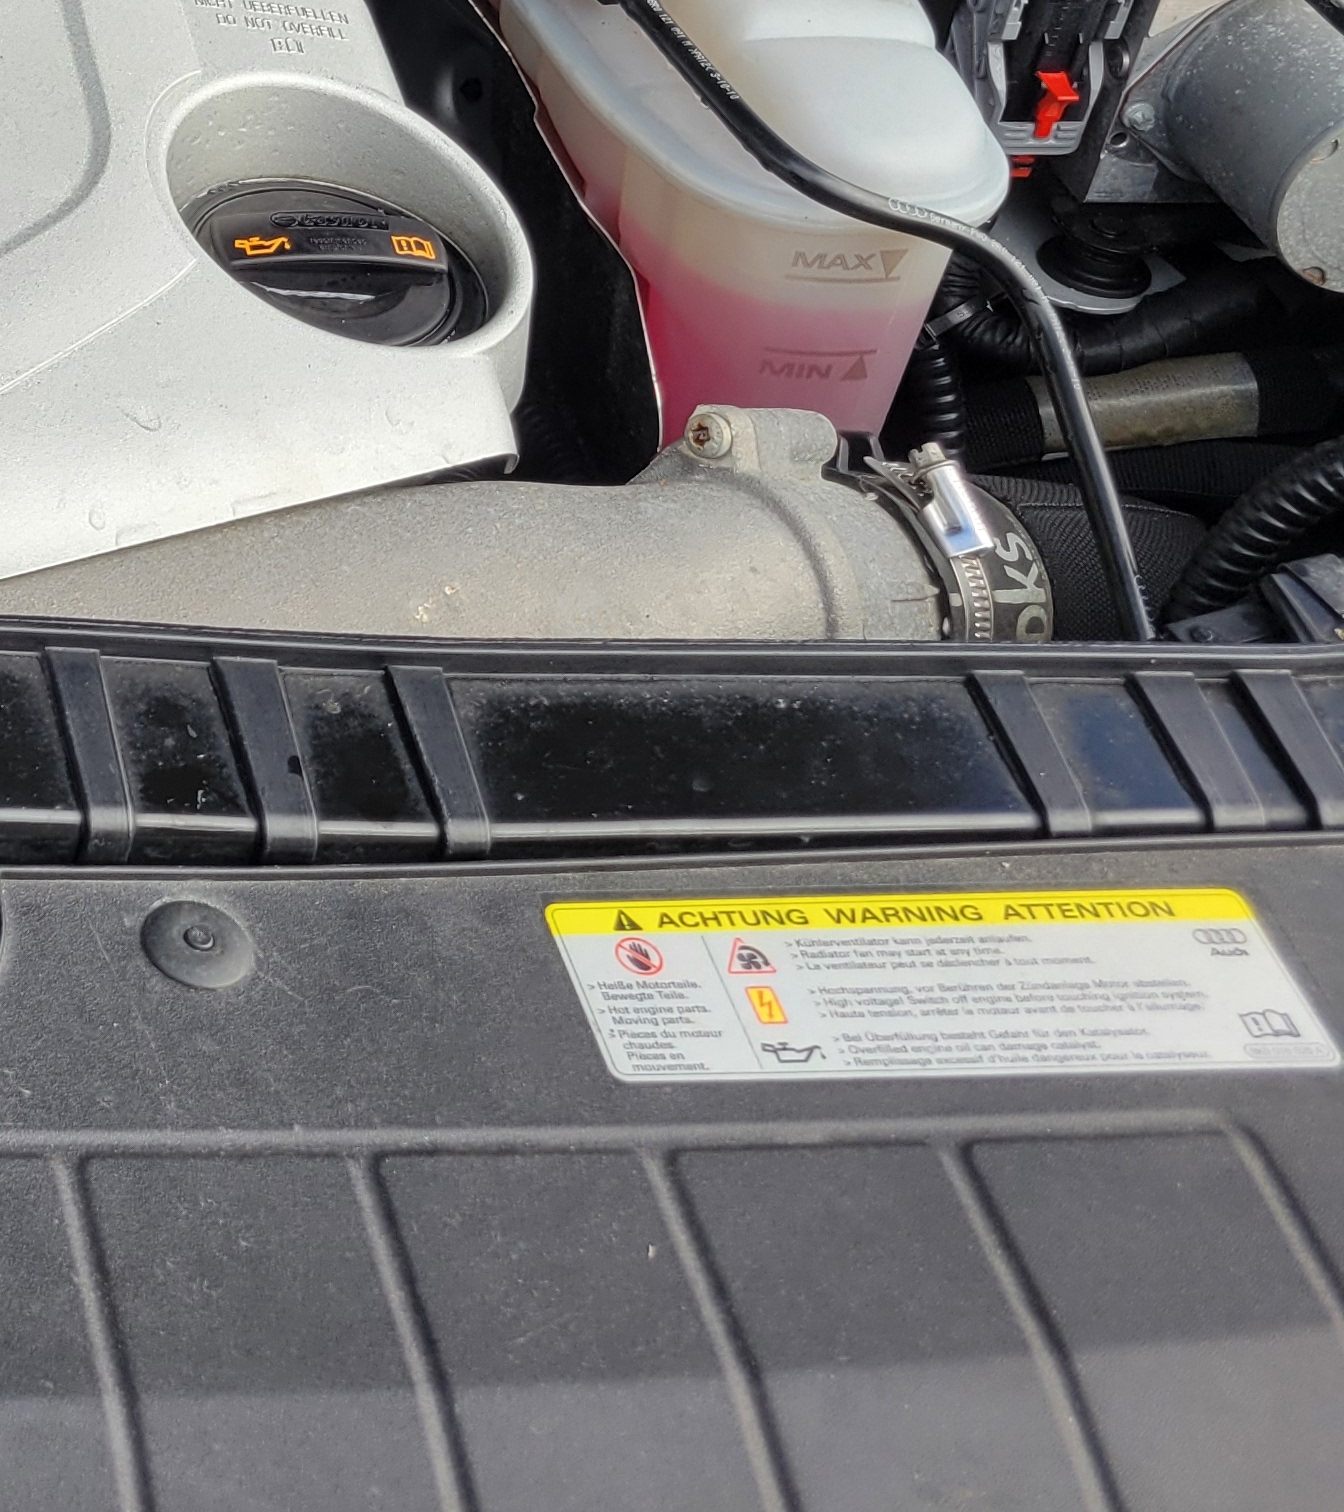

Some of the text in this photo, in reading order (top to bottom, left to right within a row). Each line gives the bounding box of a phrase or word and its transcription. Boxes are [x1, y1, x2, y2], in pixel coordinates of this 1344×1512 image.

[242, 0, 350, 24] UEBERFUELLEN
[216, 13, 348, 40] DO NOT OVERFILL
[792, 250, 876, 271] MAX
[760, 358, 834, 380] MIN
[658, 900, 1176, 929] ACHTUNG WARNING ATTENTION
[799, 950, 850, 959] Radiator
[854, 949, 873, 958] fan
[876, 950, 902, 959] may
[905, 948, 932, 956] start
[936, 948, 947, 956] at
[597, 980, 702, 990] Heiße Motorteile.
[600, 990, 690, 1002] Bewegte Teile.
[608, 1006, 711, 1016] Hot engine parts.
[612, 1016, 696, 1026] Moving parts.
[660, 1030, 676, 1038] du
[679, 1030, 722, 1038] moteur
[623, 1042, 676, 1050] chaudes.
[632, 1062, 710, 1072] mouvement.
